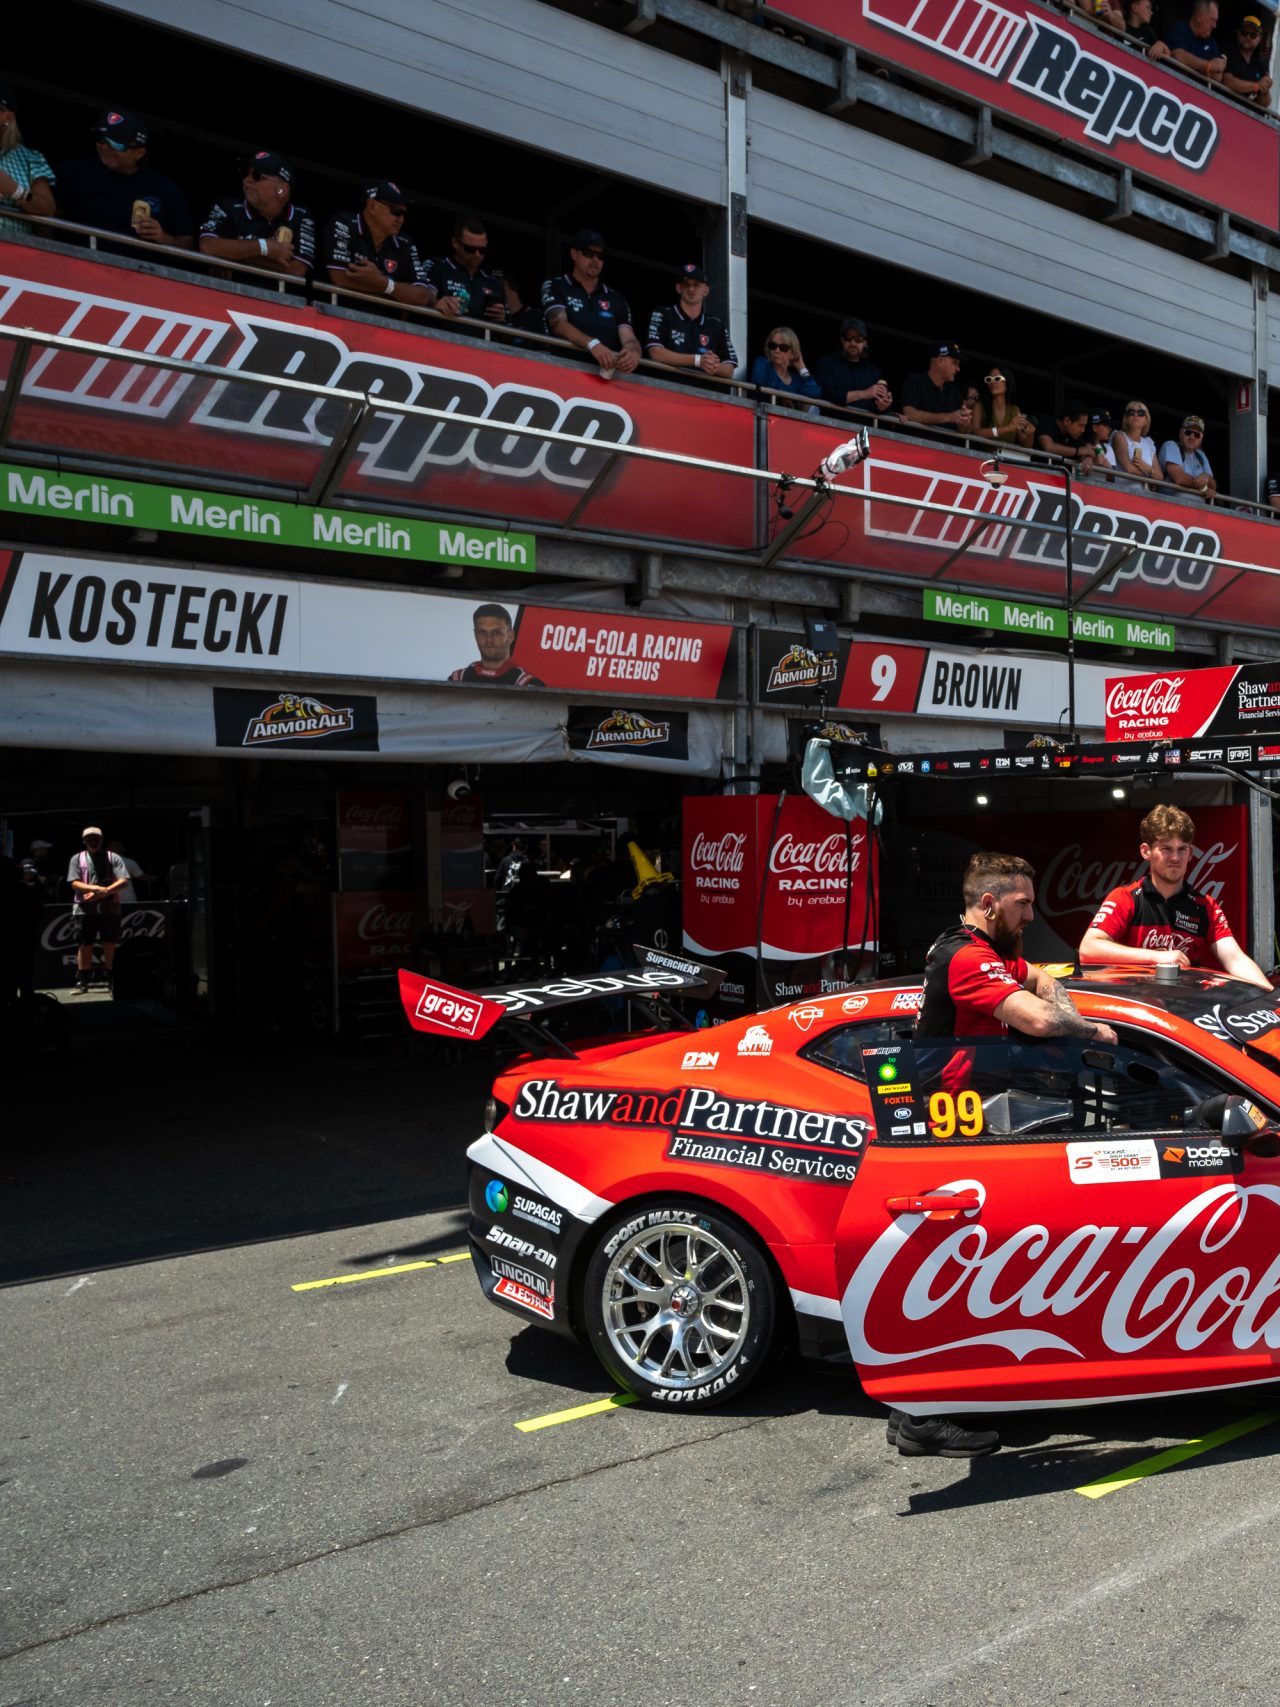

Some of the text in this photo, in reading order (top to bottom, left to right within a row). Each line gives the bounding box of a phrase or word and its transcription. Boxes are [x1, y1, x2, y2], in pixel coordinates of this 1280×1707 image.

[1009, 12, 1217, 169] Repco
[190, 310, 634, 488] Repco
[7, 472, 527, 564] Merlin Merlin Merlin Merlin
[1011, 481, 1220, 592] Repco
[28, 571, 288, 656] KOSTECKI
[935, 595, 1170, 646] Merlin Merlin Merlin
[540, 623, 702, 663] COCA-COLA RACING
[586, 656, 660, 682] BY EREBUS
[870, 654, 897, 702] 9
[932, 660, 1022, 711] BROWN
[1106, 677, 1185, 719] Coca-Cola
[1238, 708, 1265, 720] Financial
[1118, 717, 1169, 729] RACING
[1124, 731, 1135, 740] by
[1190, 749, 1223, 760] SCTR
[1229, 749, 1249, 761] grays
[691, 832, 747, 872] Coca-Cola
[769, 833, 865, 873] Coca-Cola
[696, 877, 739, 889] RACING
[778, 878, 853, 891] RACING
[787, 895, 846, 907] by erebus
[645, 950, 701, 976] SUPERCHEAP
[423, 989, 474, 1014] grays
[884, 1095, 915, 1105] FOXTEL
[929, 1090, 983, 1138] 99
[668, 1136, 856, 1182] Financial Services
[1110, 1157, 1140, 1168] 500
[1188, 1157, 1223, 1168] mobile
[513, 1195, 563, 1227] SUPAGAS
[603, 1209, 698, 1259] SPORT MAXX
[494, 1258, 548, 1296] LINCOLN
[503, 1281, 550, 1316] ELECTRIC
[651, 1366, 739, 1402] DUNLOP
